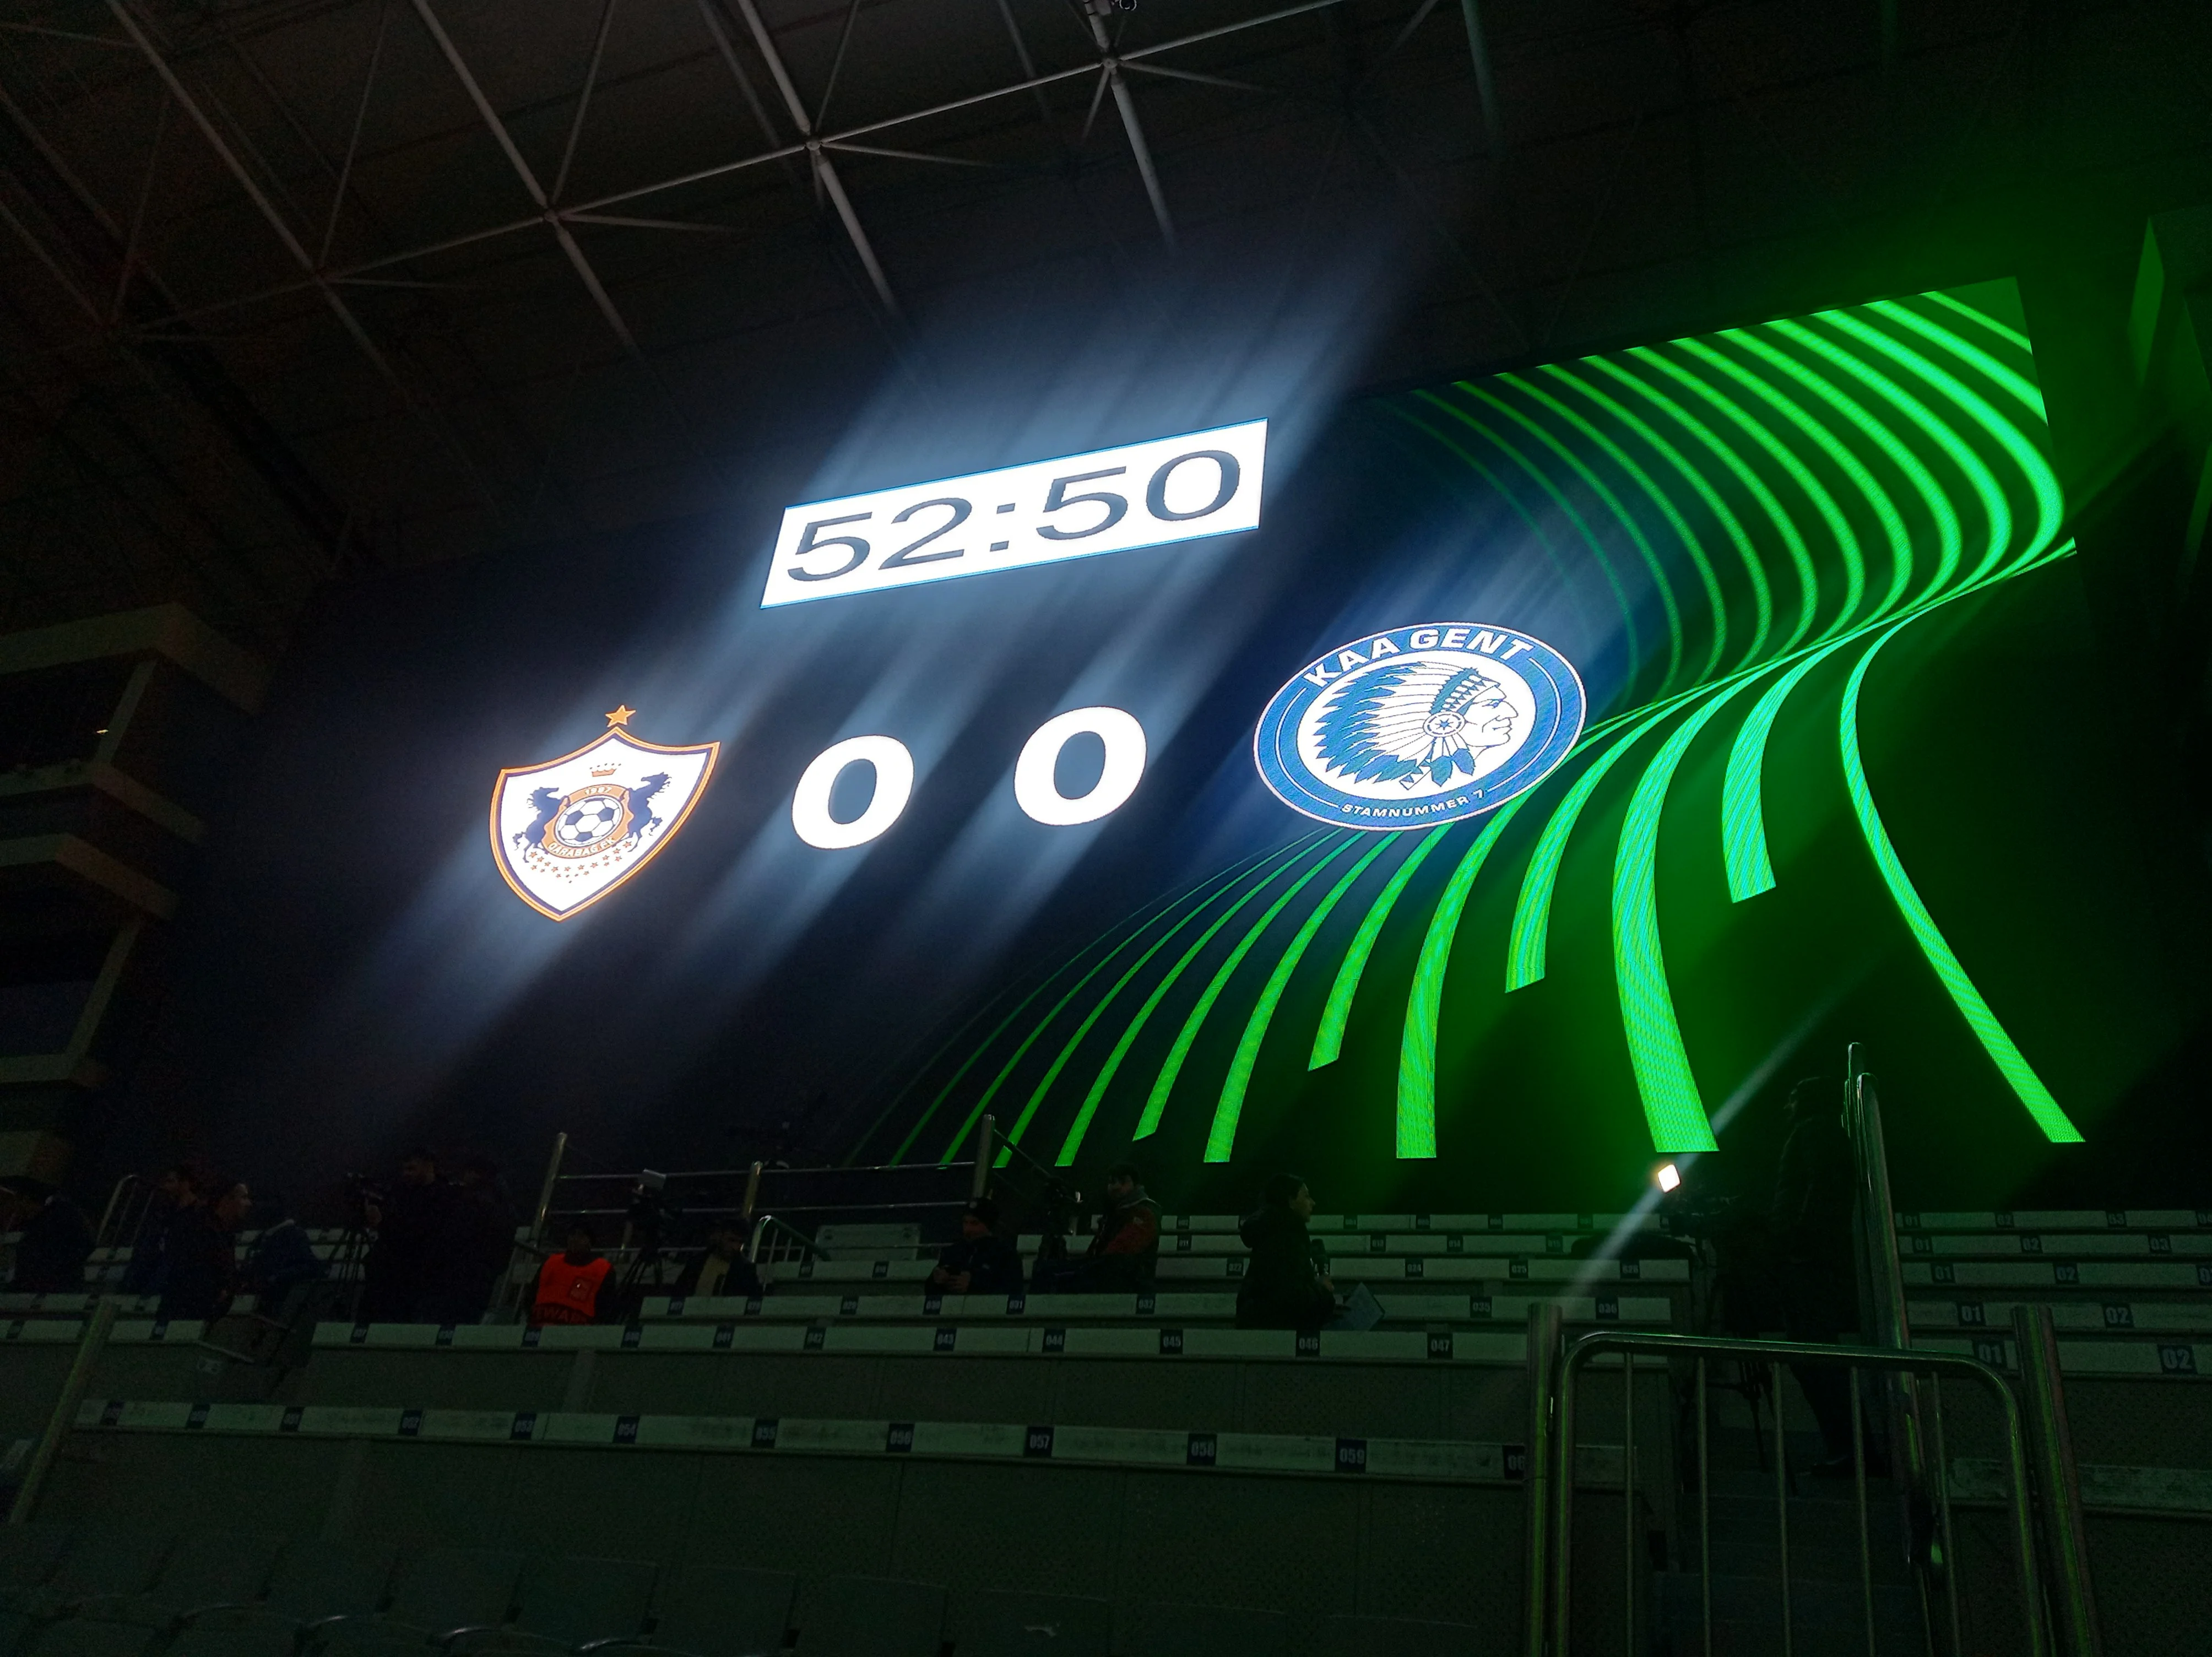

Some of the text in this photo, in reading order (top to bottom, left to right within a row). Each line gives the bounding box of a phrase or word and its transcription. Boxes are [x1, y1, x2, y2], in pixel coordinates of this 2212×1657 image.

[788, 449, 1240, 582] 52:50
[1303, 628, 1535, 686] KAA GENT
[791, 706, 1147, 849] 0 0
[584, 786, 612, 795] 1987
[1341, 789, 1484, 817] STAMNUMMER 7
[600, 837, 616, 849] FK
[1905, 1215, 1918, 1226] 01
[1997, 1215, 2013, 1226] 02
[1915, 1239, 1930, 1251] 01
[2023, 1238, 2040, 1251] 02
[2150, 1238, 2170, 1251] 03
[1934, 1266, 1953, 1281] 01
[2056, 1266, 2077, 1281] 02
[1138, 1299, 1154, 1309] 032
[1472, 1302, 1490, 1312] 035
[1961, 1305, 1982, 1322] 01
[2105, 1306, 2130, 1323] 02
[1163, 1336, 1181, 1347] 045
[1299, 1337, 1319, 1350] 046
[1430, 1340, 1451, 1352] 047
[1978, 1344, 2003, 1364] 01
[2161, 1347, 2193, 1370] 02
[1029, 1433, 1051, 1450] 057
[1338, 1447, 1365, 1465] 059
[1507, 1454, 1526, 1471] 06
